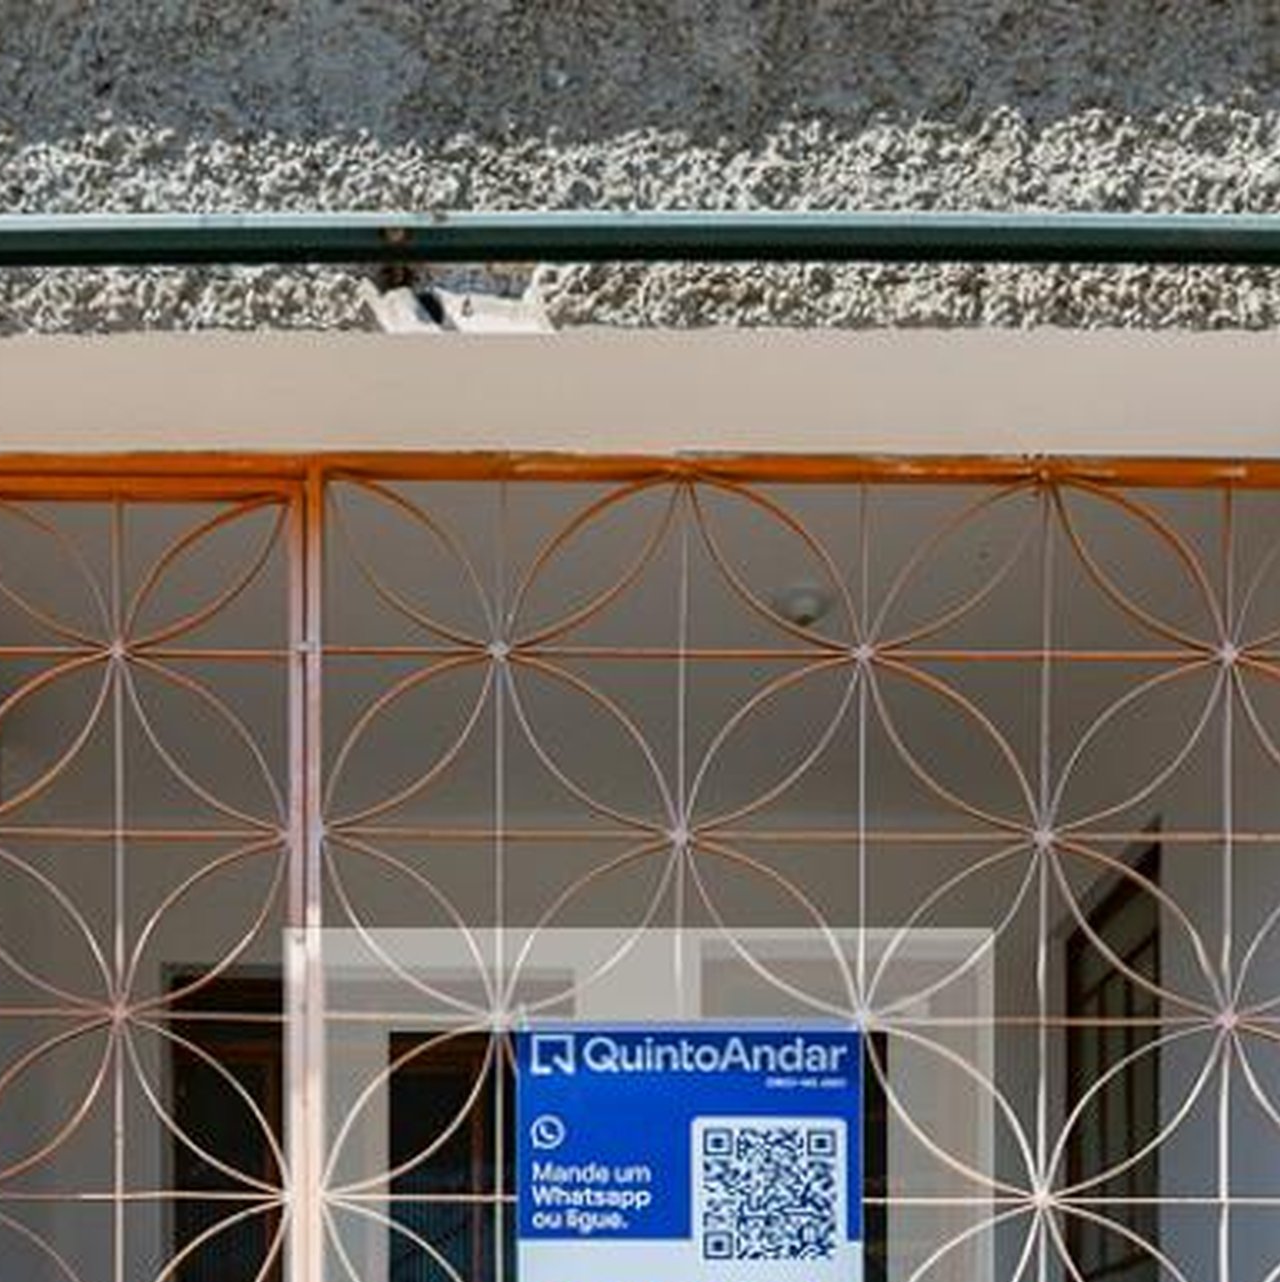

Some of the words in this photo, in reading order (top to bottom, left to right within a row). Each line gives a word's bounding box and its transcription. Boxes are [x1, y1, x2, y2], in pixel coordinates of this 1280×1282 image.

[582, 1036, 848, 1073] QuintoAndar
[532, 1161, 610, 1184] Mande
[614, 1165, 652, 1184] um
[531, 1185, 652, 1210] Whatsapp
[532, 1211, 561, 1230] ou
